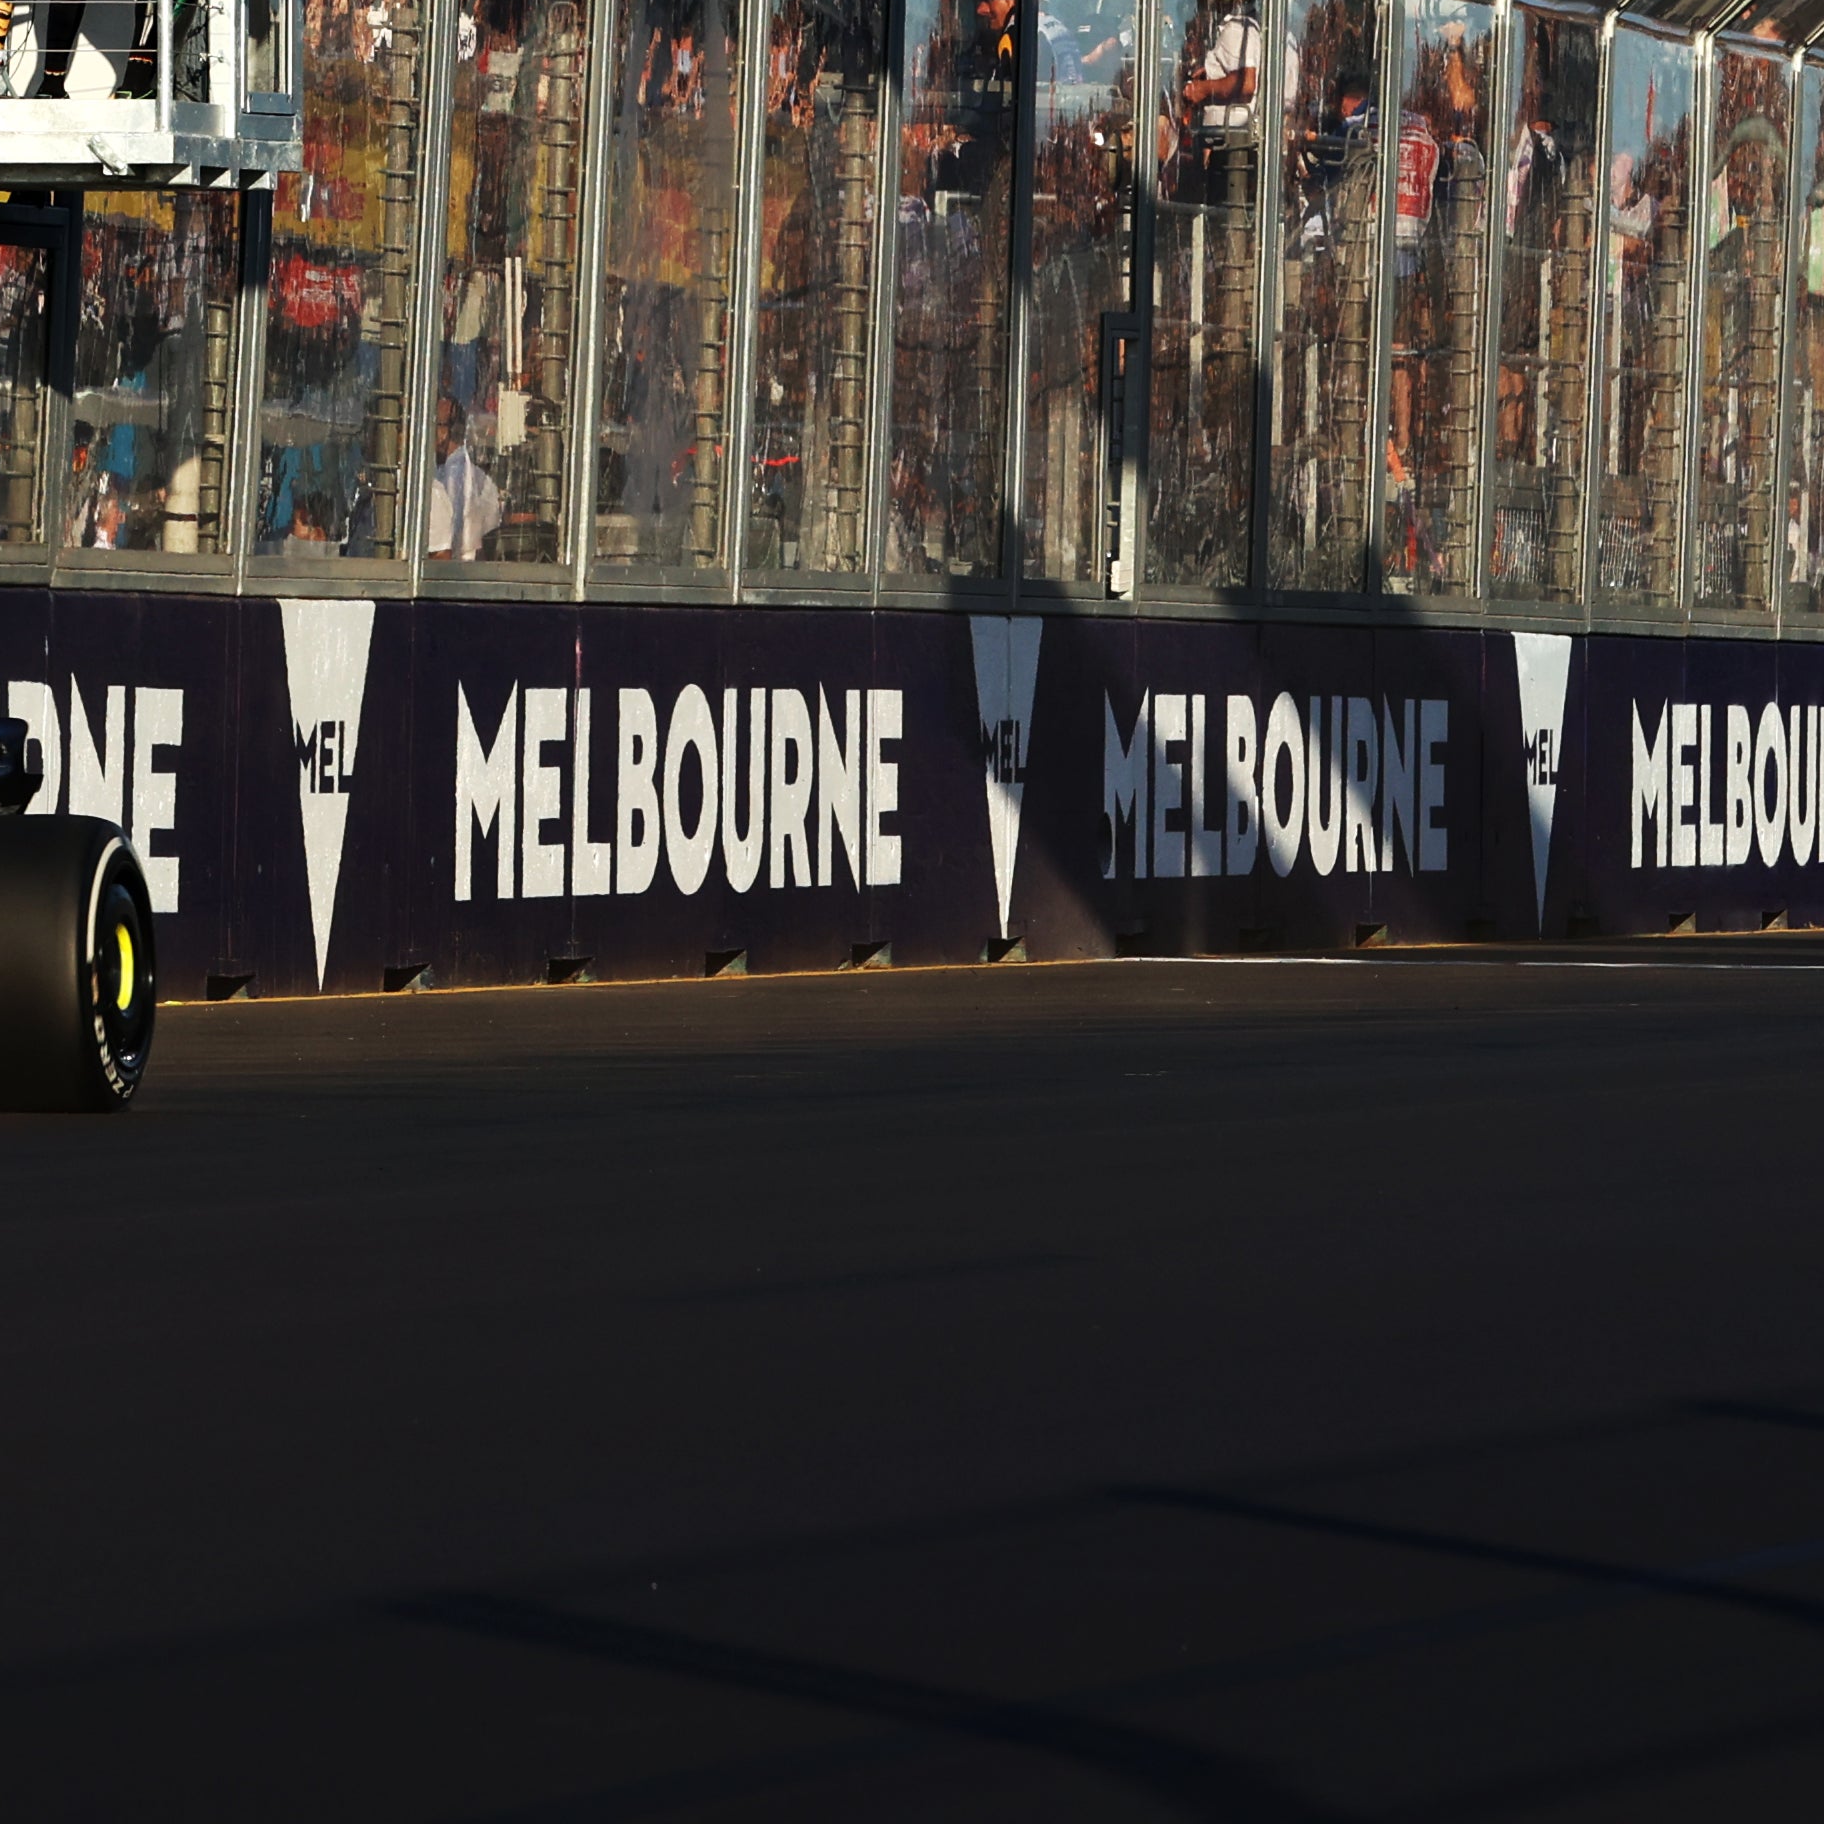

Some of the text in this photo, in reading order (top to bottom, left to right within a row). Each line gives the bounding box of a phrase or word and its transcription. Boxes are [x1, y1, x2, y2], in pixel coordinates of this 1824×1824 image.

[294, 720, 353, 794] MEL
[979, 719, 1027, 785] MEL
[1102, 686, 1449, 879] MELBOURNE
[1522, 728, 1558, 786] MEL
[454, 678, 904, 902] MELBOURNE
